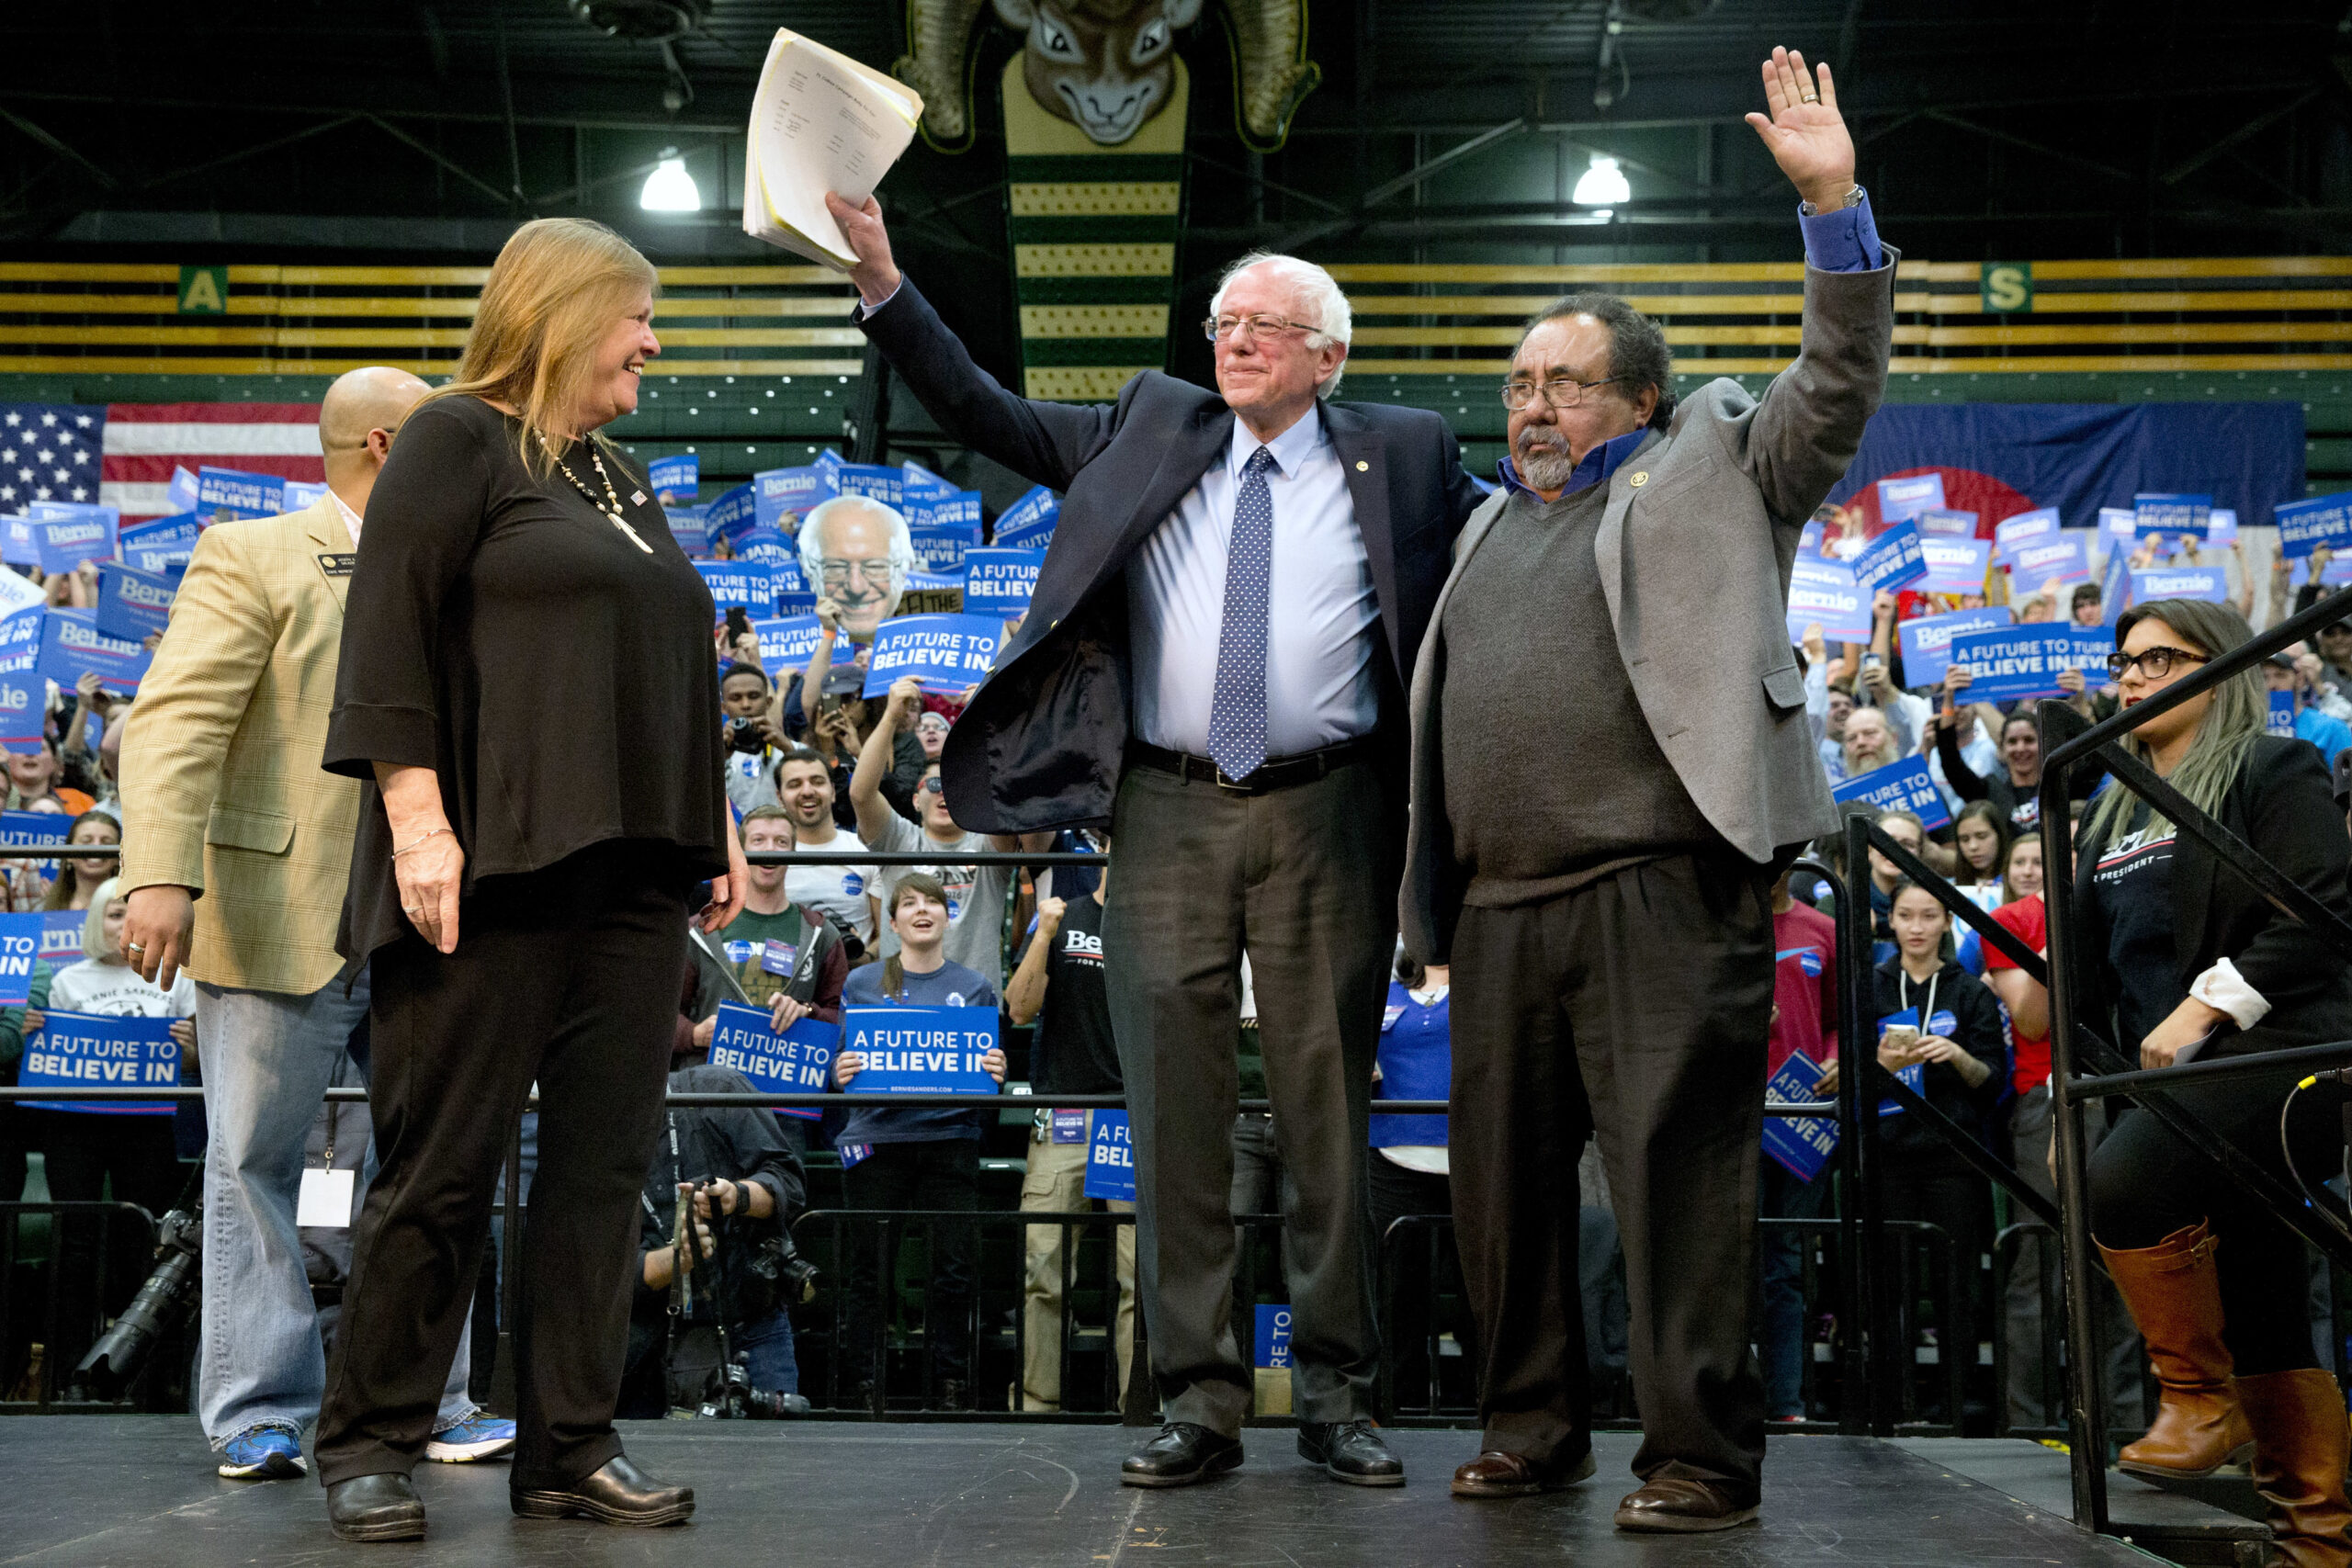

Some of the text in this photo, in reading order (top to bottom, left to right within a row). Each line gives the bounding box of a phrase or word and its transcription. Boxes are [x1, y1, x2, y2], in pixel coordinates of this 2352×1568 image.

[184, 270, 222, 310] A
[1988, 267, 2027, 310] S
[213, 479, 262, 495] FUTURE
[264, 487, 283, 500] TO
[763, 473, 817, 496] Bernie
[851, 475, 888, 488] FUTURE
[200, 491, 262, 509] BELIEVE
[2291, 506, 2344, 527] FUTURE
[47, 522, 105, 545] Bernie
[2283, 518, 2347, 543] BELIEVE
[706, 574, 747, 588] TURE
[749, 576, 769, 590] TO
[969, 565, 1039, 579] A FUTUR
[968, 580, 1036, 597] BELIEV
[2144, 572, 2214, 595] Bernie
[711, 587, 748, 602] IEVE
[752, 589, 770, 604] IN
[759, 637, 821, 659] BELIEV
[760, 633, 770, 644] A
[877, 632, 994, 652] A FUTURE TO
[2072, 640, 2113, 655] TURE
[873, 648, 991, 671] BELIEVE IN
[1957, 638, 2070, 662] A FUTURE TO
[2047, 654, 2071, 672] IN
[1855, 773, 1929, 805] TURE TO
[1911, 786, 1937, 807] IN
[2101, 855, 2155, 881] PRESIDENT
[3, 936, 34, 953] TO
[1077, 958, 1094, 966] FOR
[32, 1032, 176, 1058] A FUTURE TO
[718, 1026, 830, 1065] A FUTURE TO
[854, 1031, 993, 1049] A FUTURE TO
[28, 1053, 175, 1082] BELIEVE IN
[713, 1046, 826, 1089] BELIEVE IN
[855, 1051, 958, 1072] BELIEVE
[1775, 1072, 1790, 1088] A
[1097, 1123, 1110, 1141] A
[1813, 1132, 1836, 1156] IN
[1272, 1311, 1292, 1340] TO
